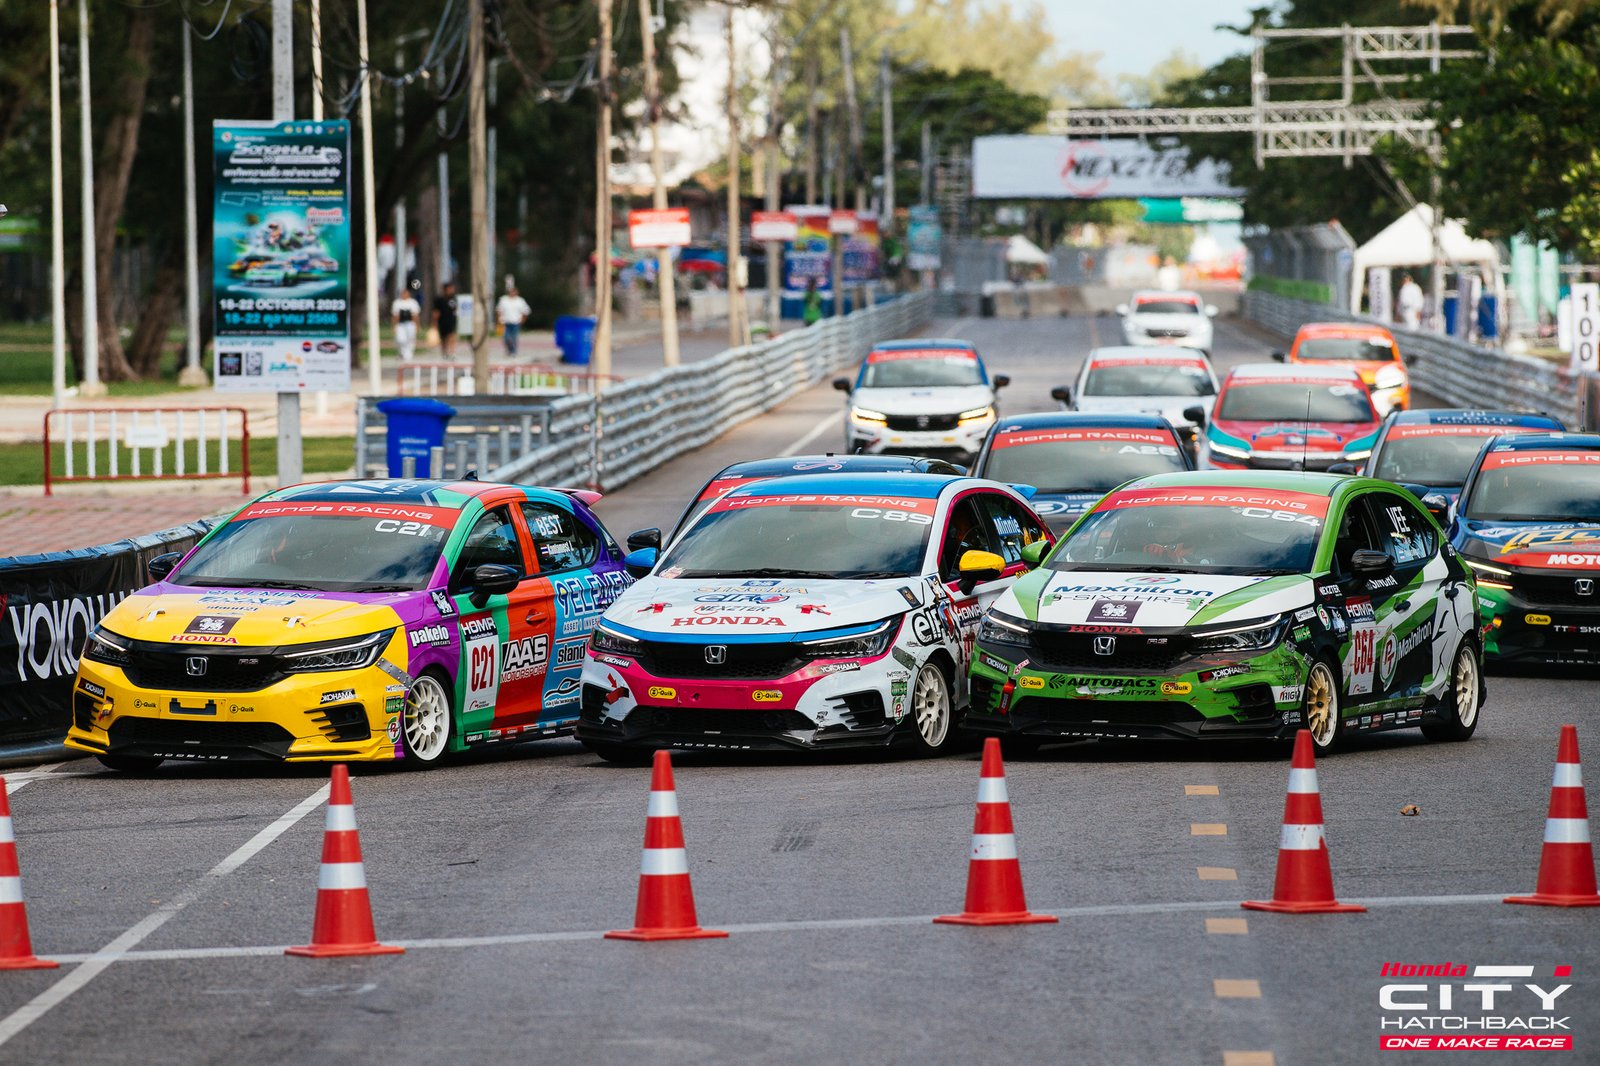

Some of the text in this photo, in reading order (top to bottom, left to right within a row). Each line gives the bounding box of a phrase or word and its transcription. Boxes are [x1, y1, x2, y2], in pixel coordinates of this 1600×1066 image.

[256, 298, 315, 311] OCTOBER
[317, 298, 346, 311] 2023
[1579, 293, 1593, 362] 100
[1009, 432, 1164, 444] Honda RACING
[1402, 428, 1473, 436] Honda
[1500, 455, 1580, 464] Honda
[729, 495, 919, 508] Honda RACING
[1115, 494, 1308, 509] Honda RACING
[247, 504, 434, 520] Honda RACING
[1241, 507, 1320, 527] C64
[1386, 506, 1410, 532] VEE
[374, 520, 432, 538] C21
[536, 515, 563, 536] BEST
[1053, 585, 1214, 598] Maxnitron
[671, 616, 787, 627] HONDA
[409, 624, 450, 647] pakelo
[1068, 625, 1145, 635] HONDA
[172, 635, 240, 644] HONDA
[1398, 621, 1432, 661] Maxnitron
[504, 635, 548, 673] AAS
[1354, 630, 1374, 675] C64
[471, 643, 495, 692] C21
[603, 656, 630, 668] YOKOHAMA
[821, 662, 860, 673] YOKOHAMA
[985, 659, 1009, 674] YOKOHAMA
[502, 663, 547, 684] MOTORSPORT
[1066, 677, 1157, 688] AUTOBACS
